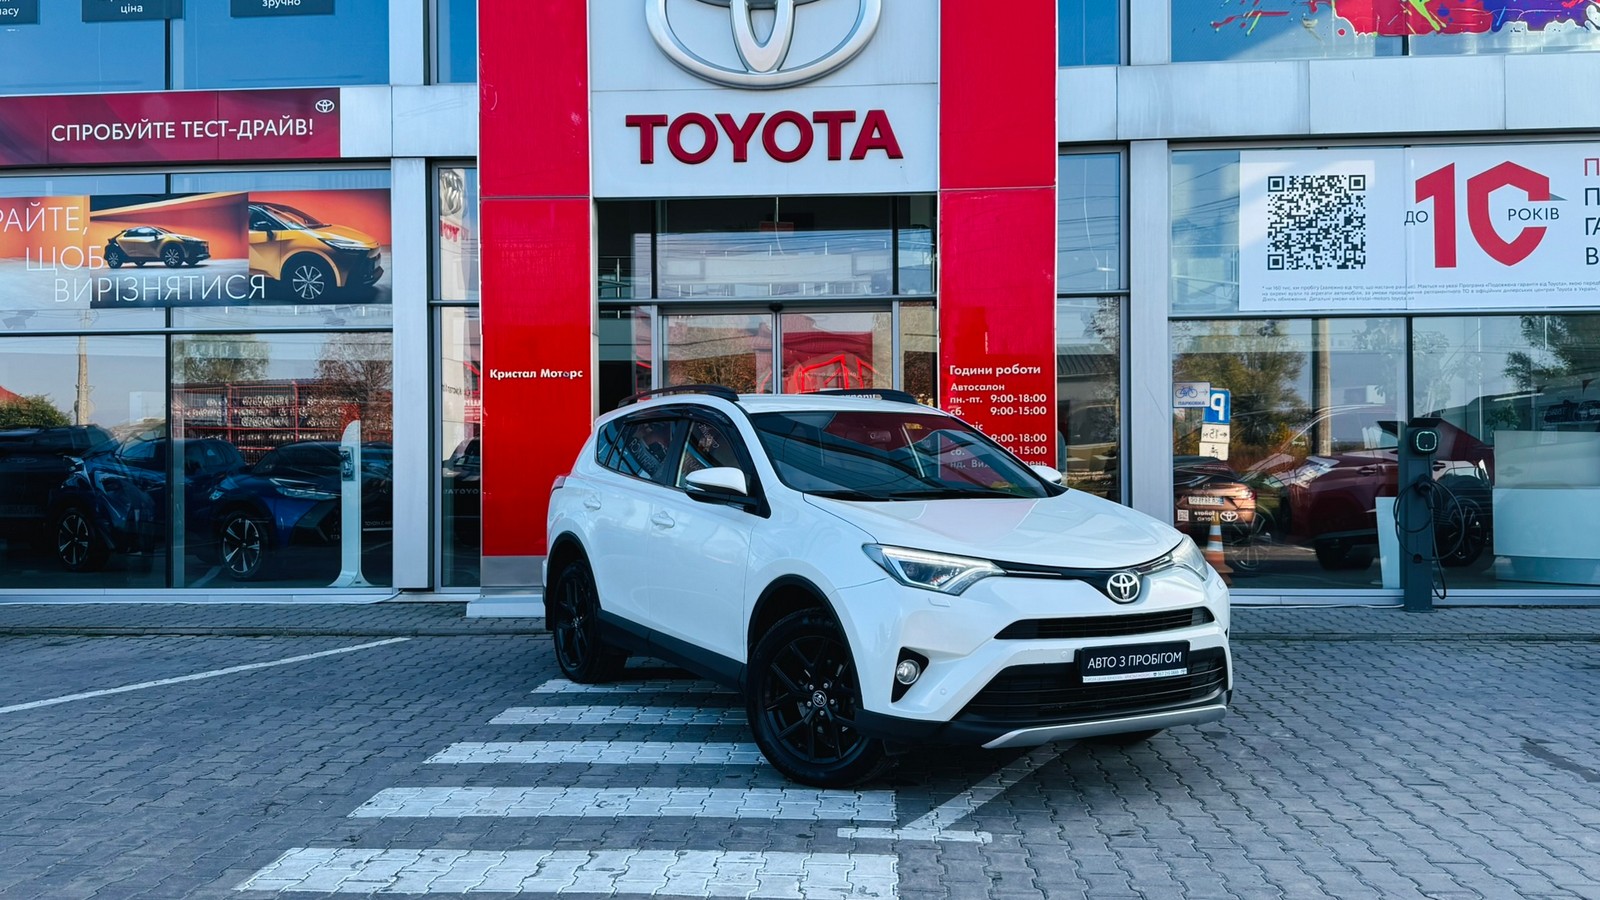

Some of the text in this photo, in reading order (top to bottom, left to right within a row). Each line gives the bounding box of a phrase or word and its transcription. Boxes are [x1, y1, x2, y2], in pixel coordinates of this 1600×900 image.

[120, 3, 143, 14] ціна
[51, 115, 314, 142] СПРОБУЙТЕ ТЕСТ-ДРАЙВ!
[626, 109, 904, 165] TOYOTA
[1404, 210, 1429, 226] ДО
[1507, 207, 1560, 221] РОКІВ
[25, 245, 104, 275] ЩОБ
[54, 274, 265, 302] ВИРІЗНЯТИСЯ
[489, 368, 584, 381] Кристал Моторс
[949, 363, 1041, 377] Години роботи
[950, 383, 1005, 391] Автосалон
[950, 393, 1047, 404] пн.-пт. 9:00-18:00
[950, 406, 1047, 416] сб. 9:00-15:00
[990, 433, 1047, 443] 9:00-18:00
[1087, 651, 1182, 669] АВТО З ПРОБІГОМ
